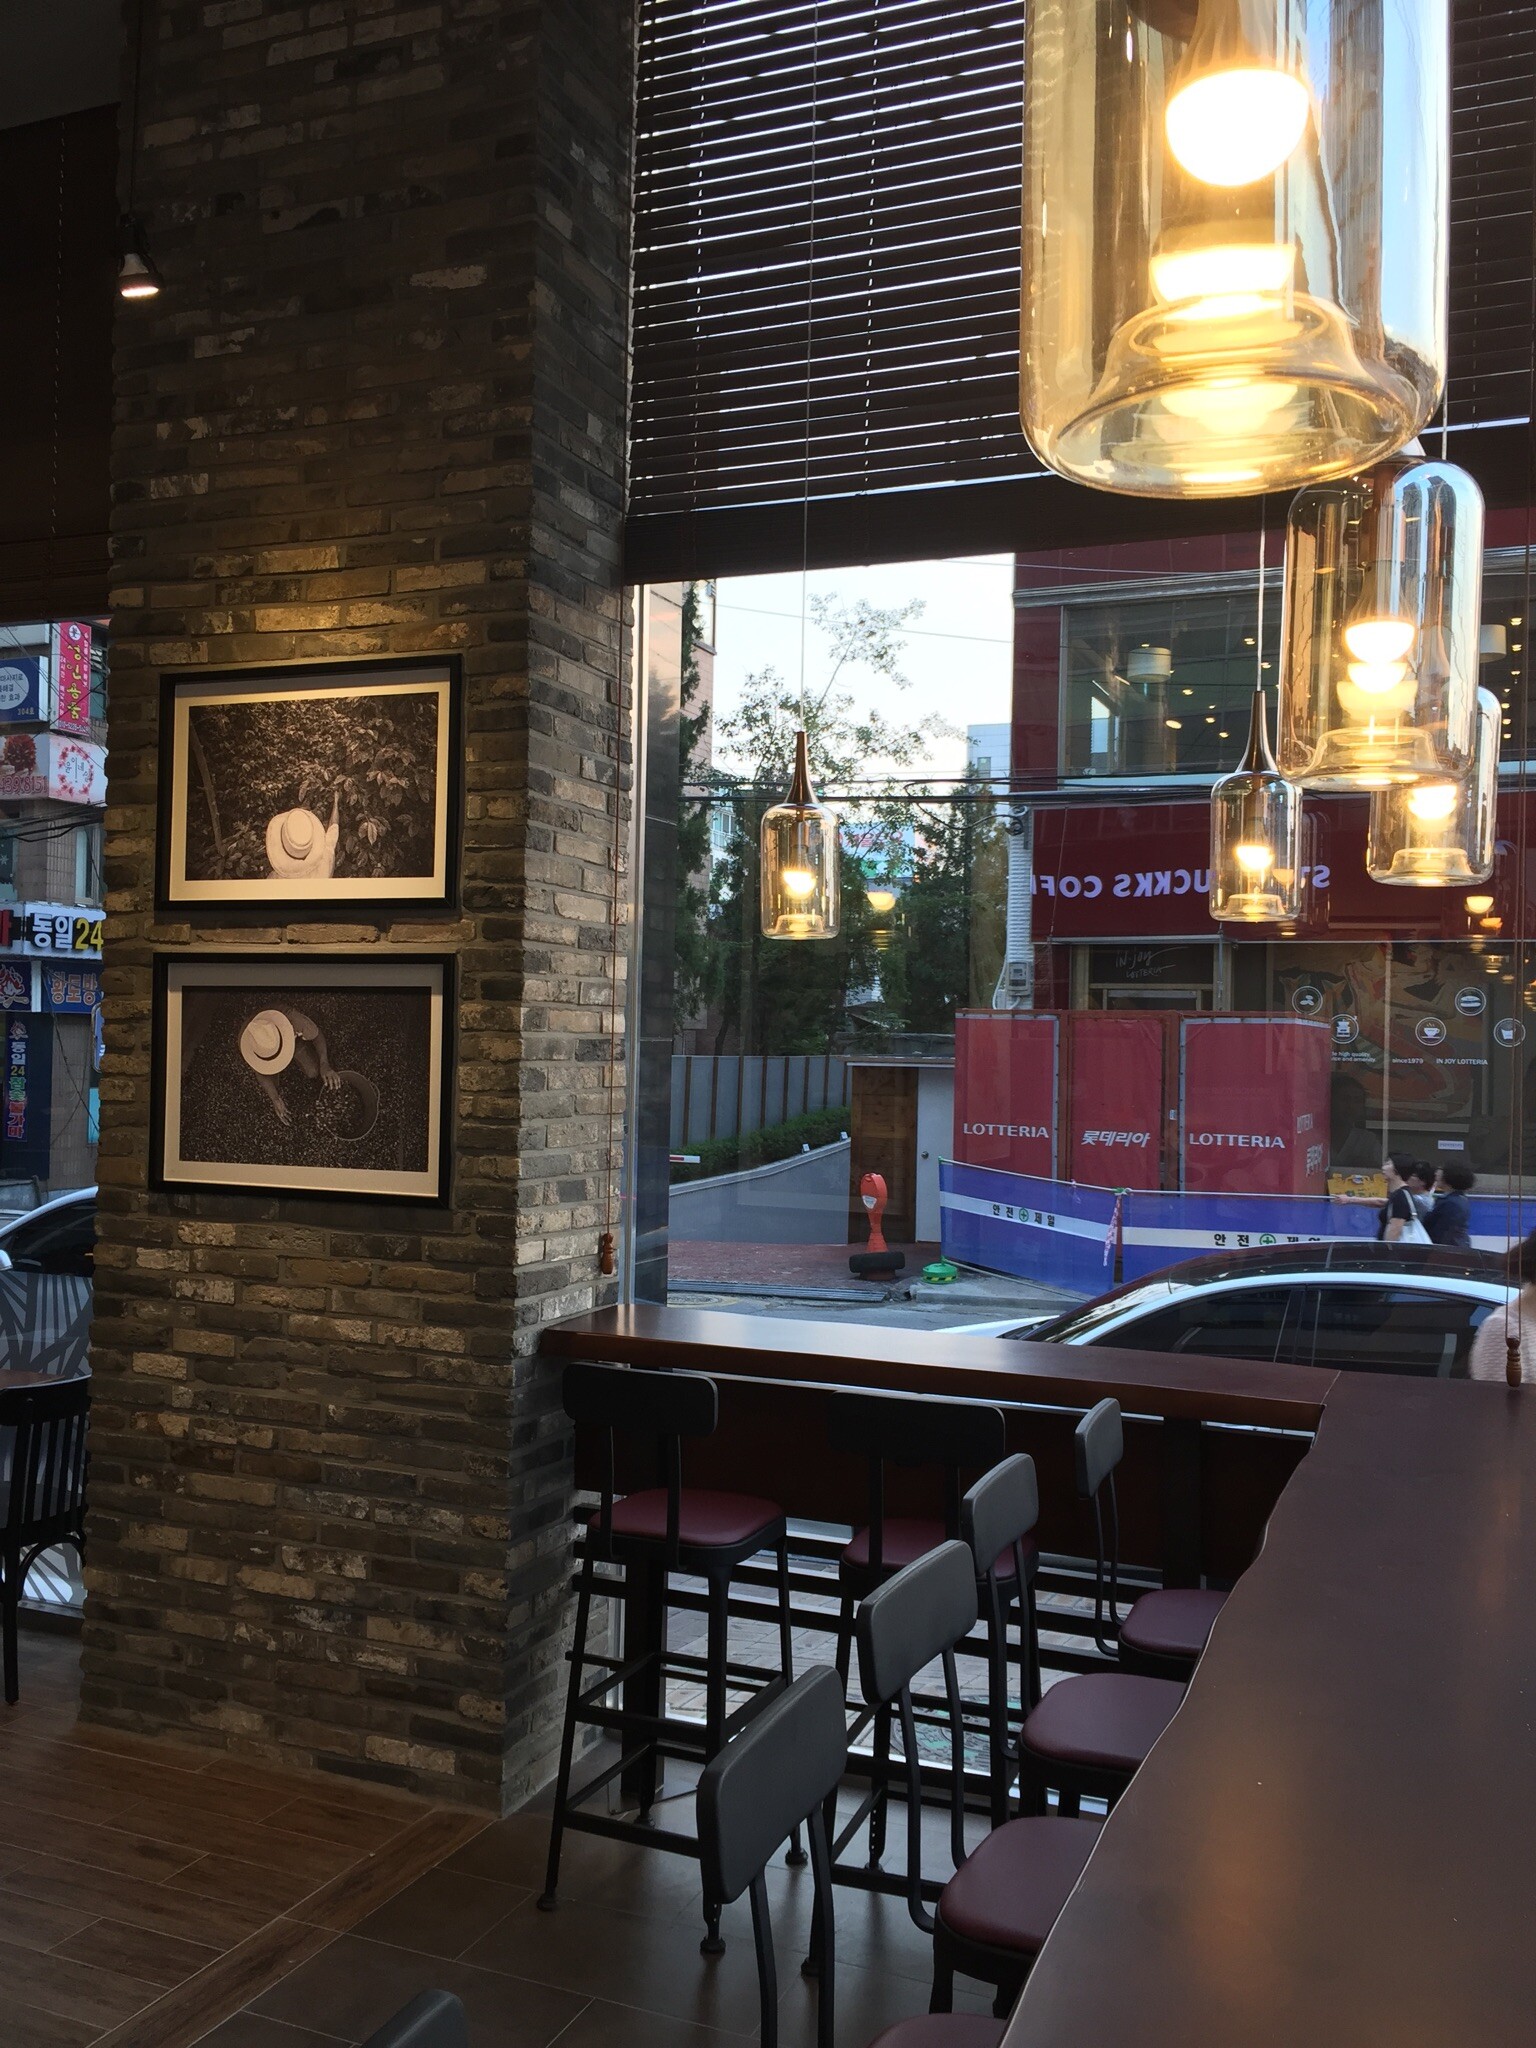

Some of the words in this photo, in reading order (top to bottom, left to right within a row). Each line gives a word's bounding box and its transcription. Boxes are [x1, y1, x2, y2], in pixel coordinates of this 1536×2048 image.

[33, 913, 104, 951] 동일24
[1457, 1058, 1488, 1066] LOTTERIA
[963, 1123, 1049, 1139] LOTTERIA
[1081, 1130, 1151, 1148] 롯데리아
[1189, 1132, 1286, 1149] LOTTERIA
